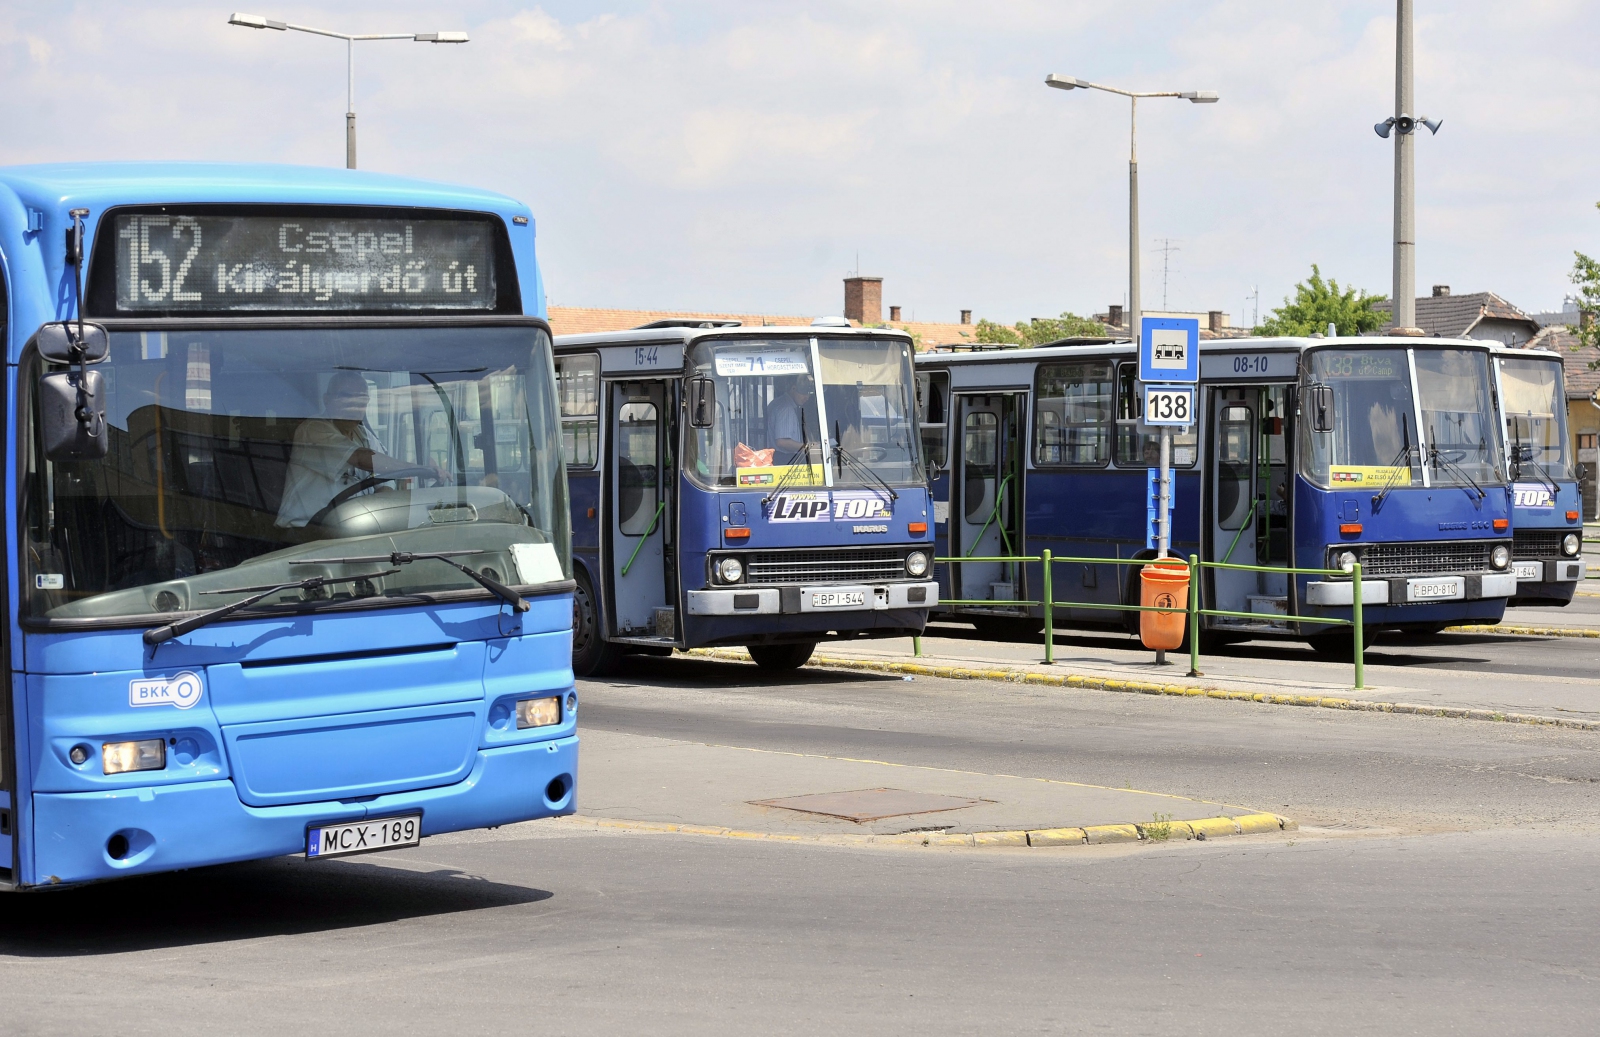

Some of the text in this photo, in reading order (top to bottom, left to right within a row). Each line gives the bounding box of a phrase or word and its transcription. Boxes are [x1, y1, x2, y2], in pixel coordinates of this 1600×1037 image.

[278, 223, 413, 261] Csepel
[119, 216, 202, 302] 152
[442, 261, 478, 294] út
[745, 356, 765, 371] 71
[1233, 356, 1268, 372] 08-10
[1325, 355, 1353, 377] 138
[1149, 395, 1187, 418] 138
[1514, 490, 1551, 506] TOP
[853, 525, 888, 534] IKARUS
[1421, 584, 1456, 596] BPO-810
[821, 593, 863, 605] BPI-544
[139, 685, 170, 699] BKK
[310, 820, 415, 853] H MCX-189
